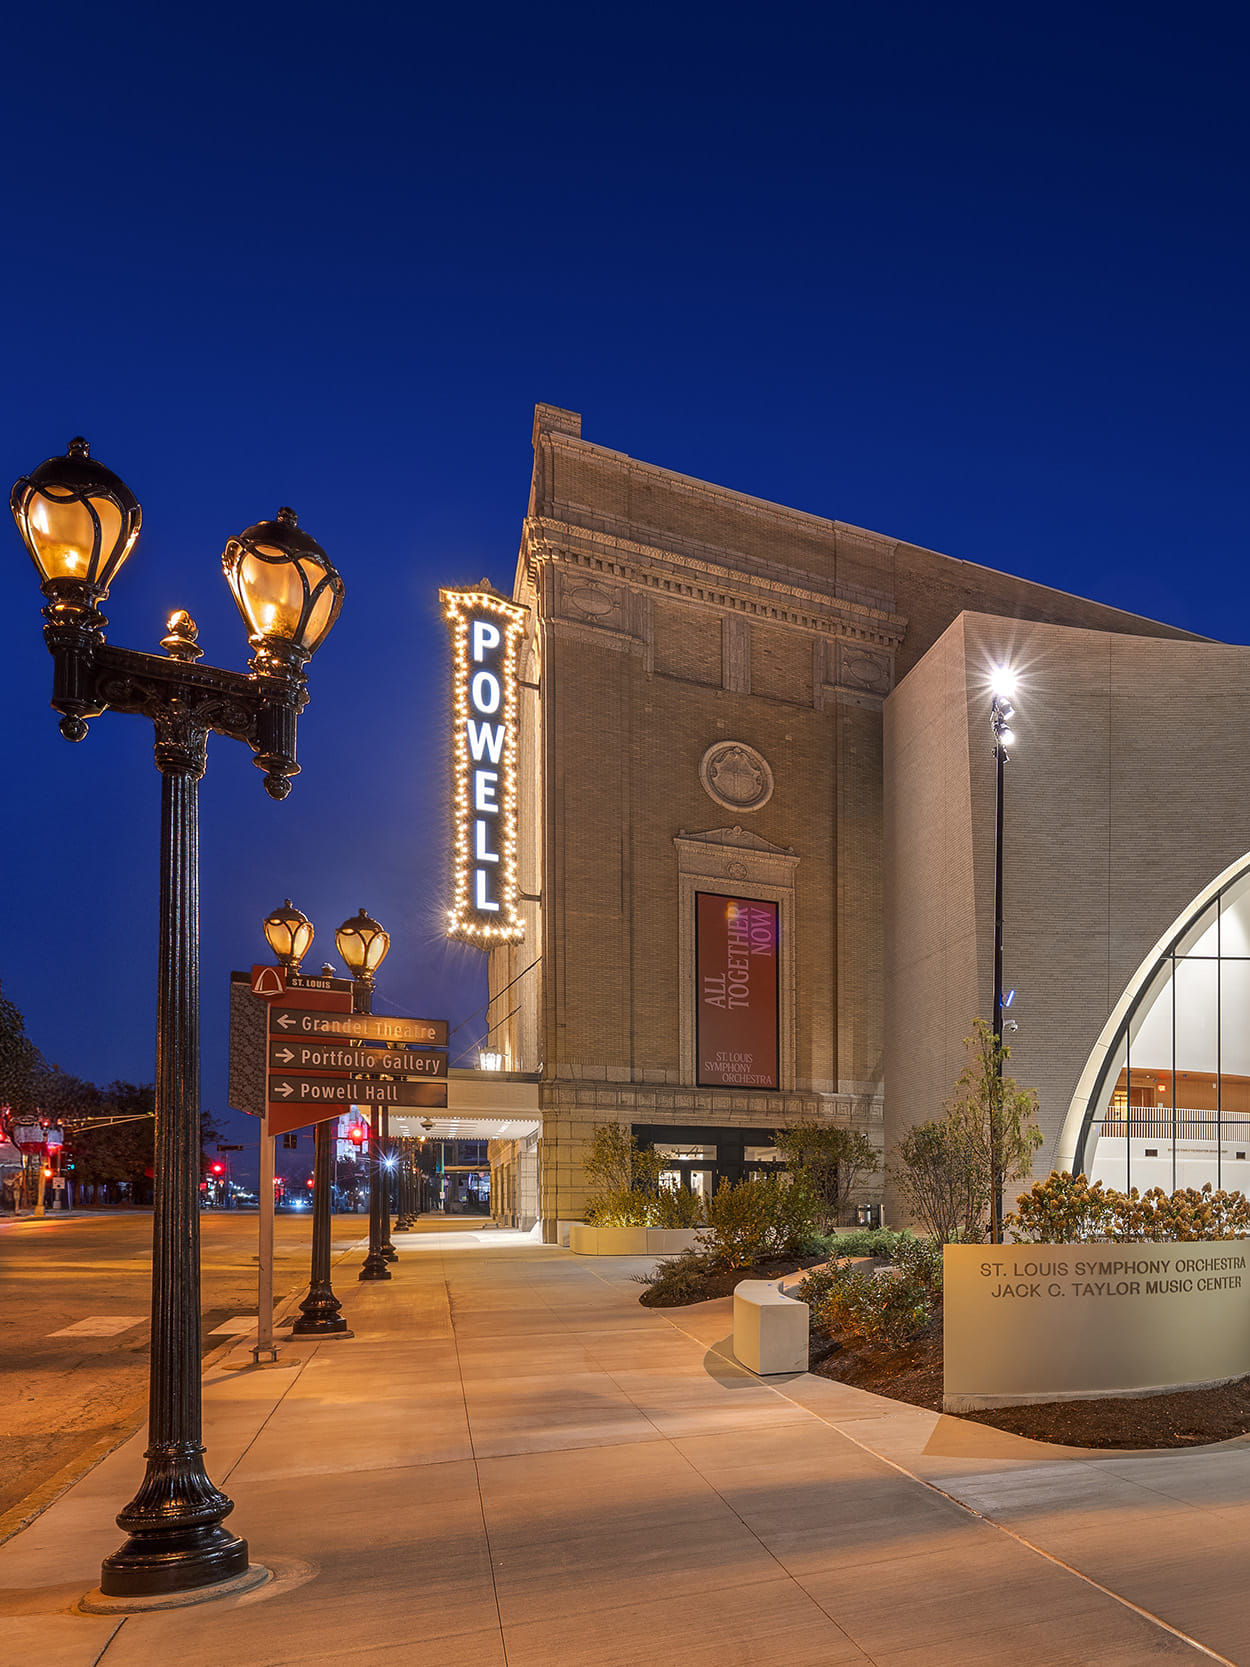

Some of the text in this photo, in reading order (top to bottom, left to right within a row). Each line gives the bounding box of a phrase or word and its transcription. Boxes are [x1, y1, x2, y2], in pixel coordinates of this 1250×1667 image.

[466, 620, 506, 912] POWELL
[750, 906, 772, 957] NOW
[727, 906, 750, 1010] TOGETHER
[291, 978, 331, 989] ST. LOUIS
[703, 971, 726, 1009] ALL
[302, 1016, 436, 1040] Grandel Theatre
[301, 1049, 440, 1075] Portfolio Gallery
[704, 1061, 752, 1073] SYMPHONY
[716, 1051, 753, 1063] ST. LOUIS
[722, 1072, 773, 1085] ORCHESTRA
[301, 1083, 399, 1101] Powell Hall
[980, 1256, 1247, 1278] ST. LOUIS SYMPHONY ORCHESTRA
[991, 1275, 1242, 1298] JACK C. TAYLOR MUSIC CENTER
